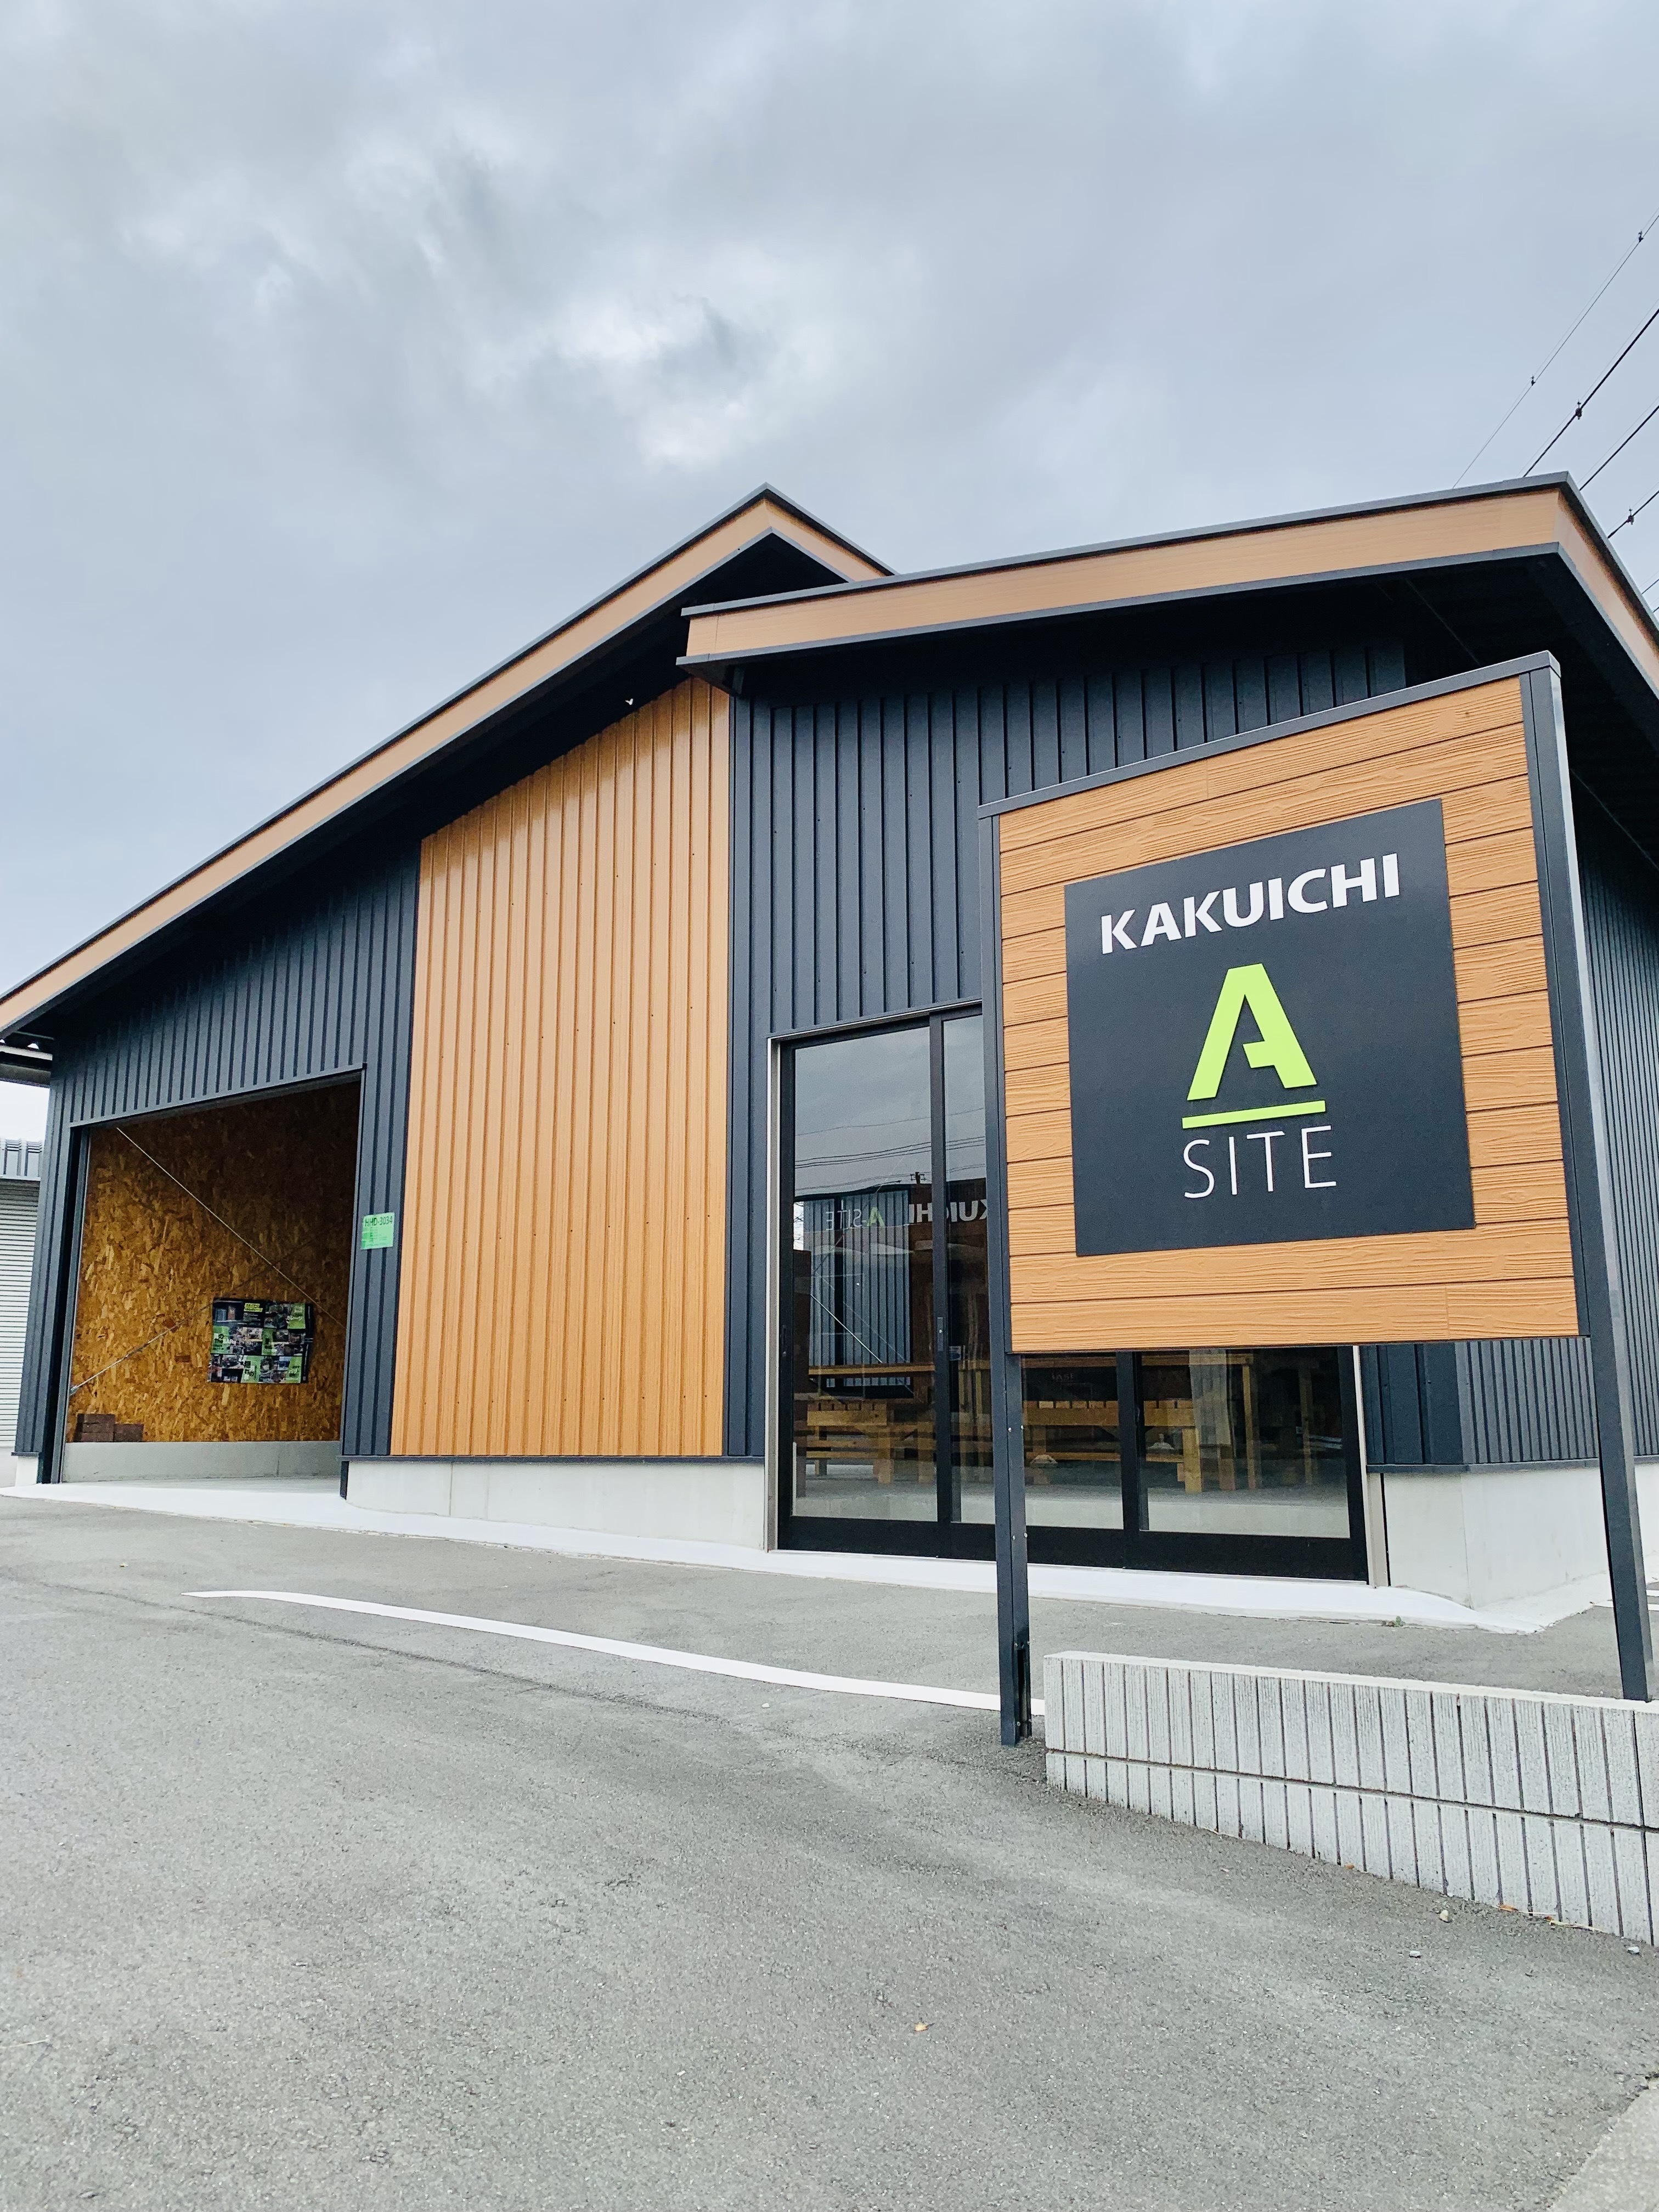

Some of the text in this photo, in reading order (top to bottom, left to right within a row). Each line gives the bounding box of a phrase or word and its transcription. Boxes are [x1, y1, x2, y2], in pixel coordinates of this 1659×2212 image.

[1101, 853, 1400, 955] KAKUICHI
[1187, 963, 1317, 1101] A
[1183, 1125, 1337, 1199] SITE
